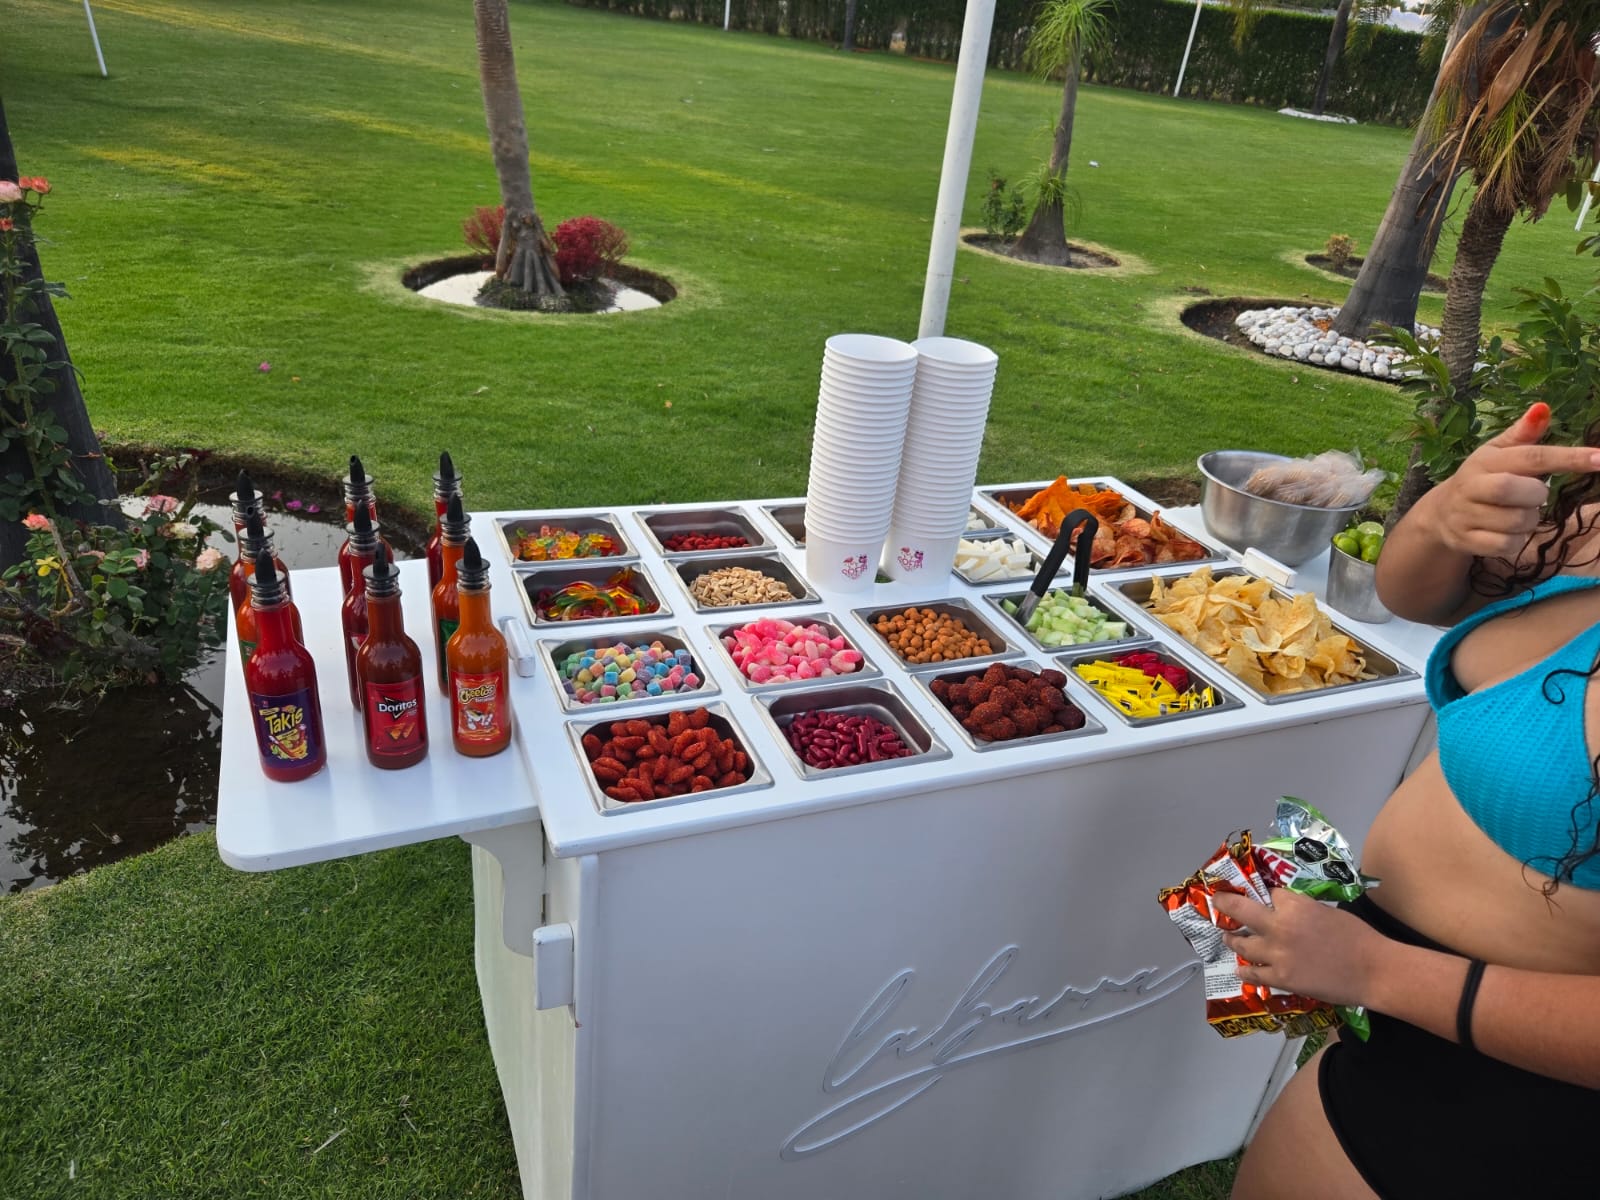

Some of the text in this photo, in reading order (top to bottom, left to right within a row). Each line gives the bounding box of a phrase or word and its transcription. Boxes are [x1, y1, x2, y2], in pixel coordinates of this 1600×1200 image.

[460, 686, 495, 703] Cheetos
[378, 699, 417, 712] Doritos
[265, 707, 303, 734] Takis
